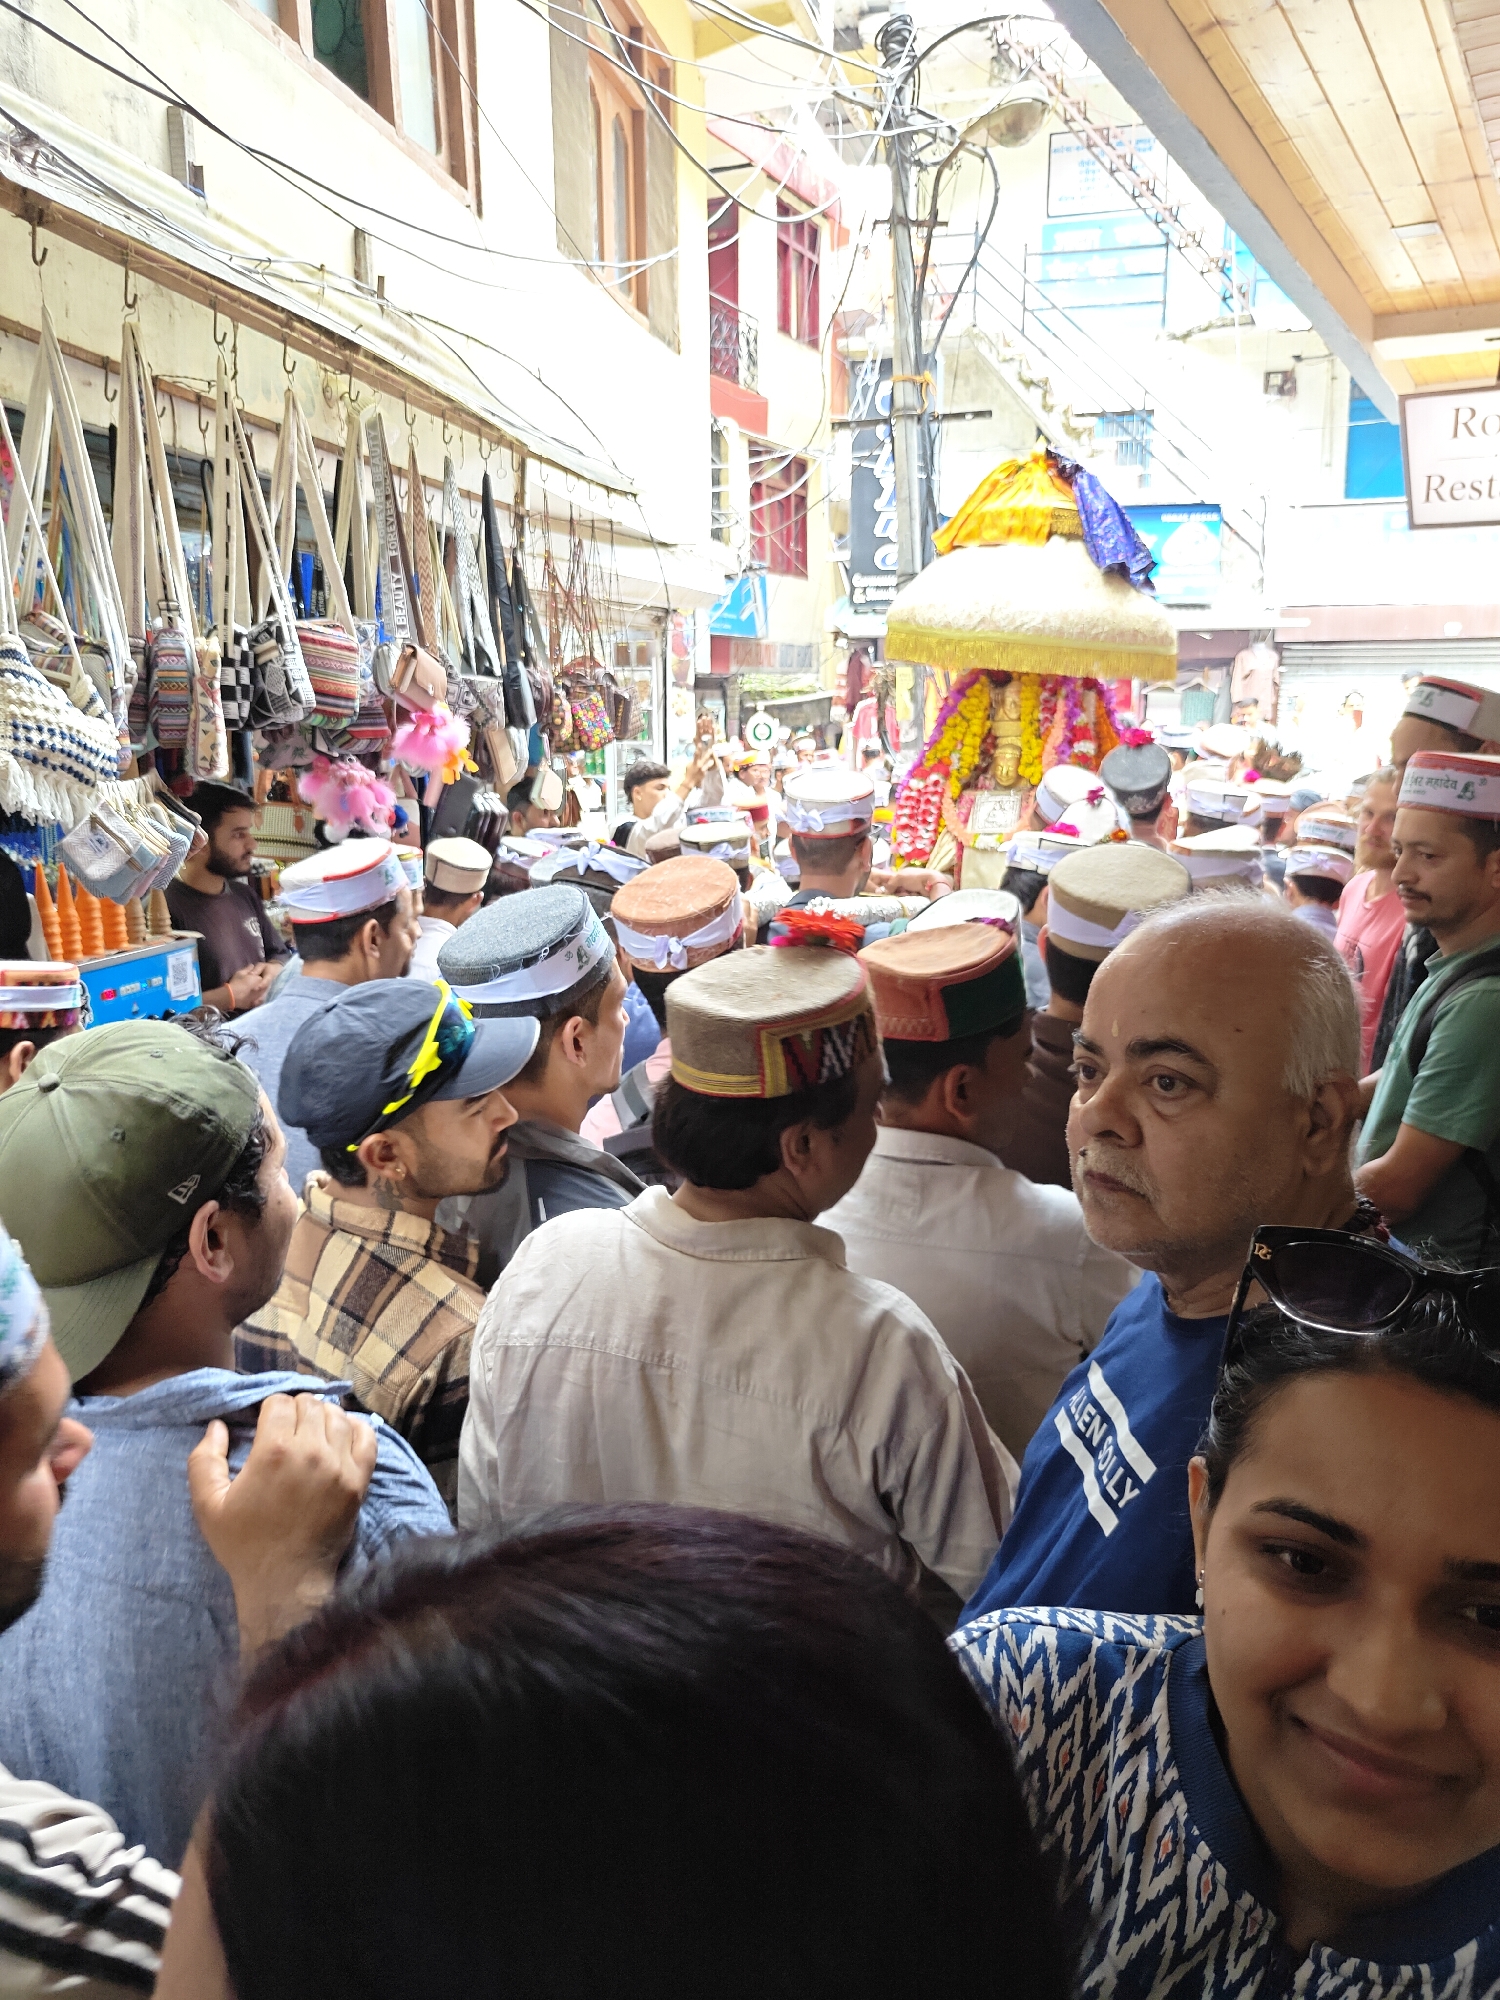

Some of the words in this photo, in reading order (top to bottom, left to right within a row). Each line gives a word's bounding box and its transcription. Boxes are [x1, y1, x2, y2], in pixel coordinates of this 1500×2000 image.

[1423, 474, 1500, 503] Rest
[384, 497, 400, 557] FOREVER
[391, 573, 406, 626] BEAUTY
[1069, 1385, 1108, 1447] ALLEN
[1098, 1435, 1141, 1509] SOLLY
